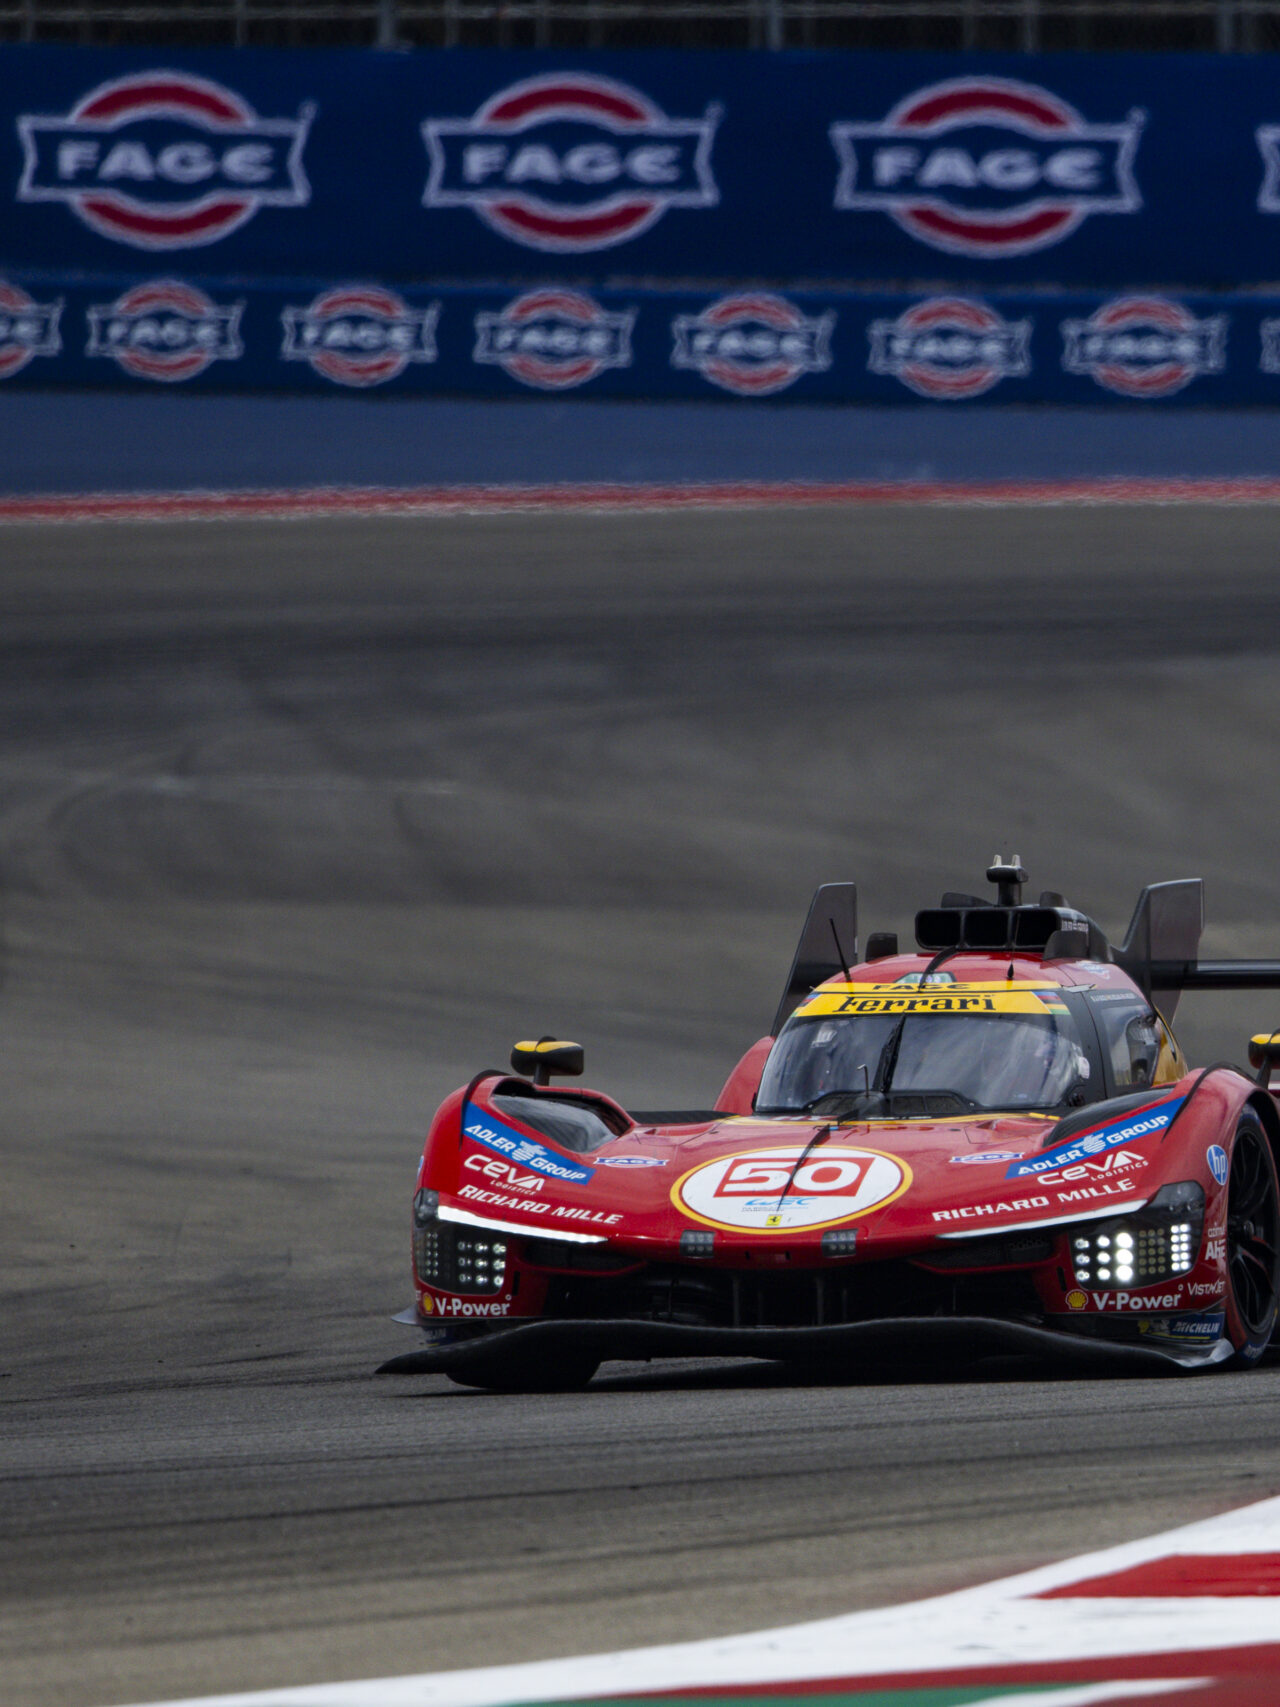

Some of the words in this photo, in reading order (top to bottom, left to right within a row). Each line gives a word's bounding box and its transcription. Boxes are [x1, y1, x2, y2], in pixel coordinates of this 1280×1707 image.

[57, 140, 276, 183] FAGE
[461, 144, 681, 185] FAGE
[872, 147, 1101, 188] FAGE
[832, 993, 997, 1013] Ferrari
[465, 1124, 517, 1153] ADLER
[530, 1156, 587, 1181] GROUP
[1017, 1149, 1084, 1175] ADLER
[1106, 1114, 1170, 1144] GROUP
[722, 1160, 862, 1193] 50
[1090, 1160, 1150, 1182] LOGISTICS
[457, 1184, 551, 1214] RICHARD
[552, 1206, 624, 1225] MILLE
[932, 1196, 1050, 1222] RICHARD
[1057, 1178, 1136, 1203] MILLE
[434, 1297, 511, 1316] V-Power
[1093, 1291, 1182, 1311] V-Power
[1172, 1320, 1221, 1335] MICHELIN
